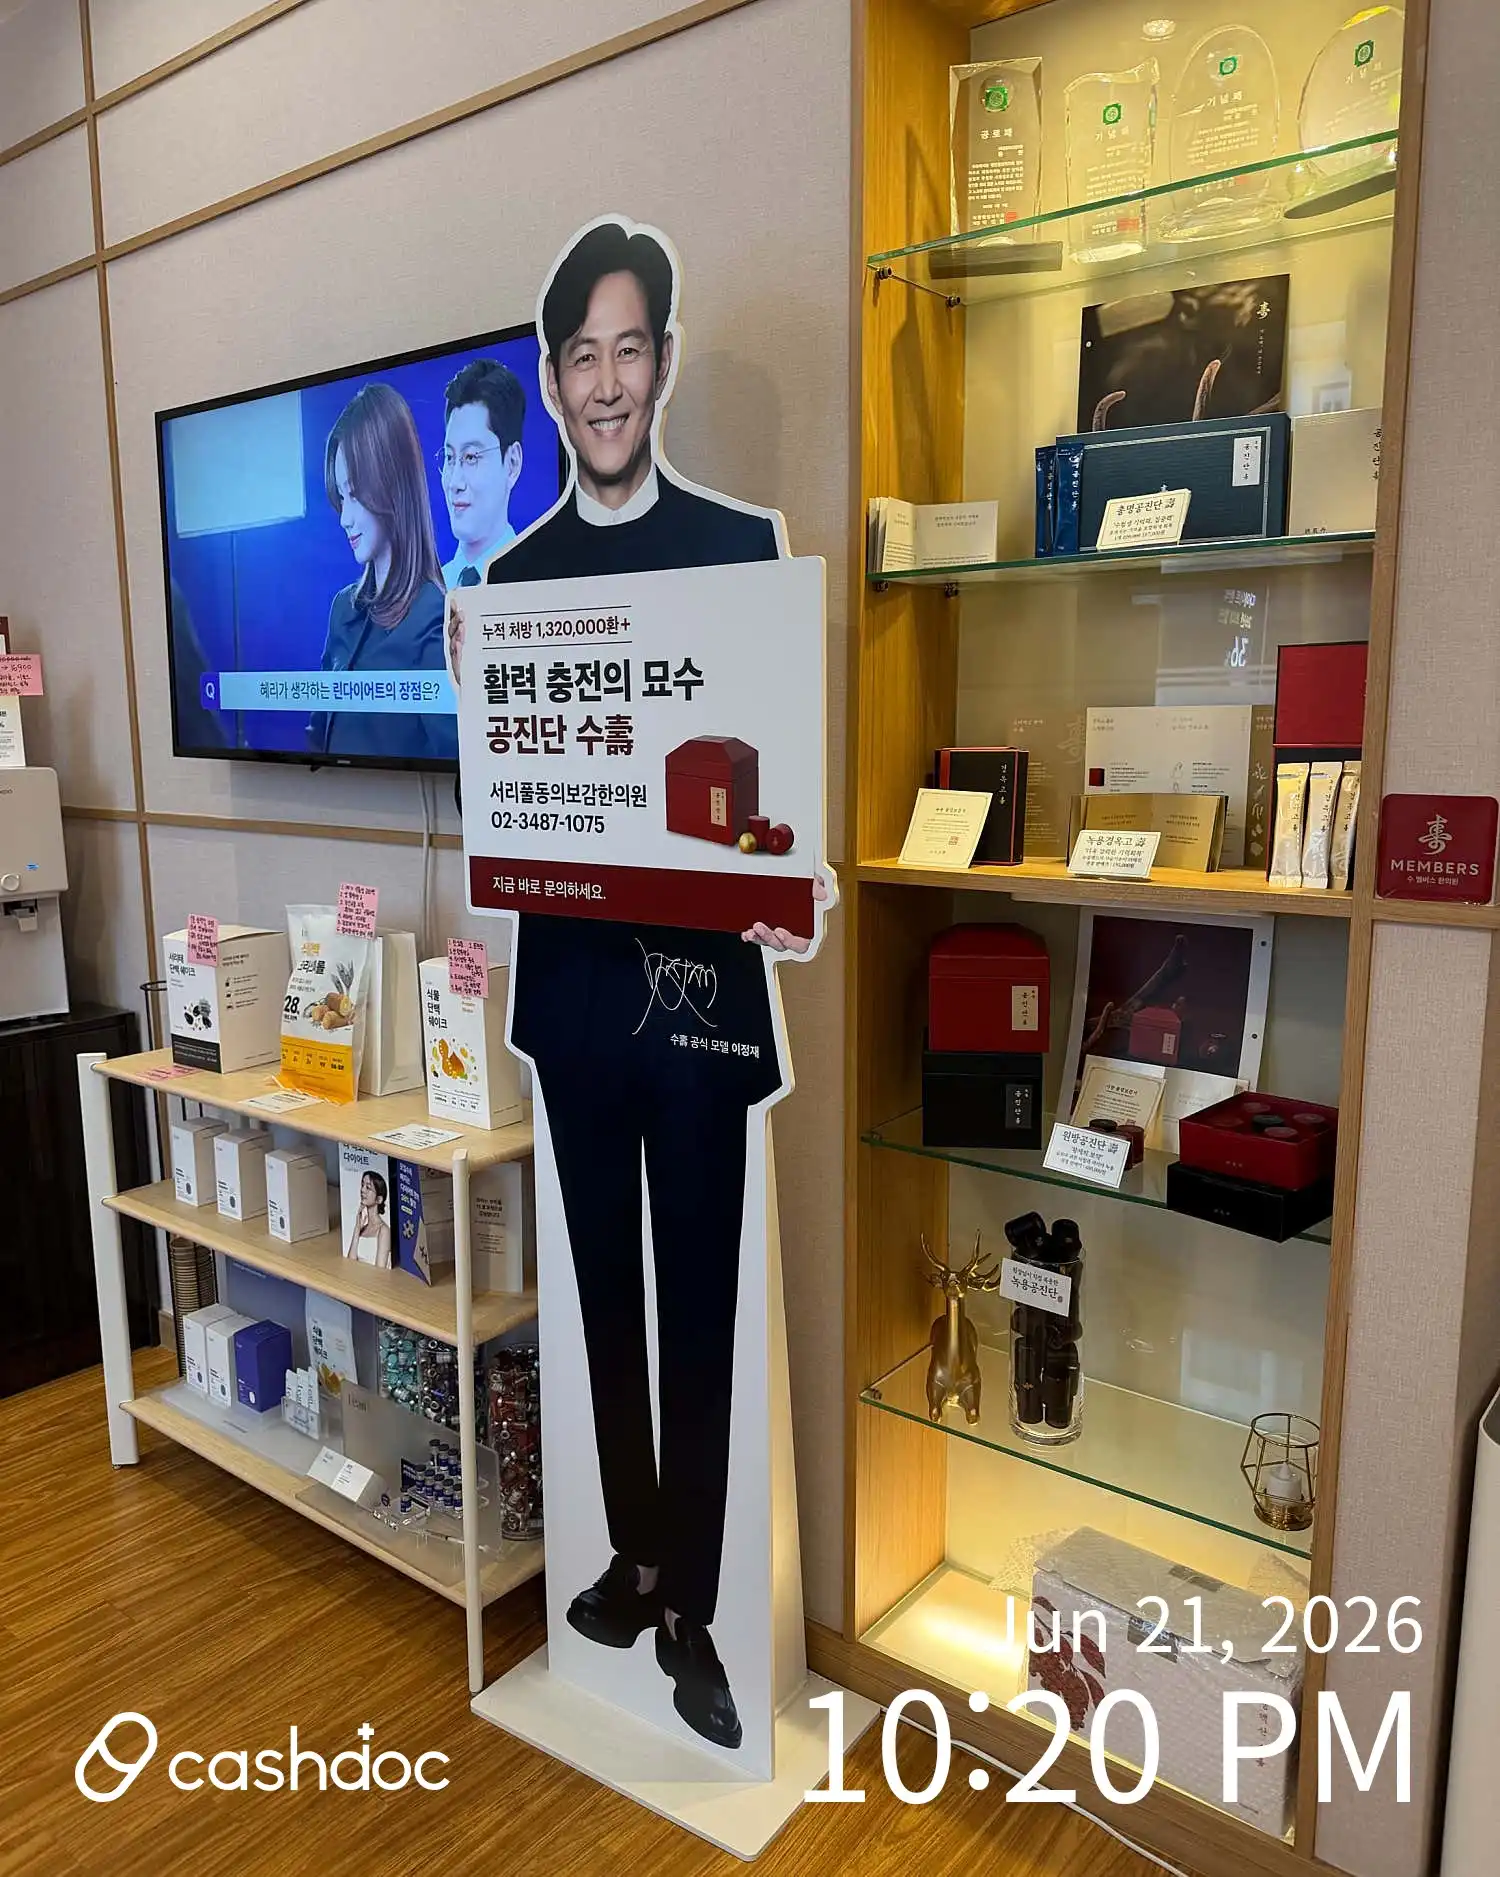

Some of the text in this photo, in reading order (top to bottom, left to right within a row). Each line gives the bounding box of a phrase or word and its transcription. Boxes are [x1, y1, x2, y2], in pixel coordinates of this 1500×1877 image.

[482, 616, 631, 641] 누적 처방 1,320,000환+
[205, 682, 216, 700] Q
[260, 681, 441, 701] 혜리가 생각하는 린다이어트의 장점은?
[483, 657, 704, 705] 활력 충전의 묘수
[486, 714, 634, 756] 공진단 수壽
[490, 780, 648, 808] 서리풀동의보감한의원
[491, 811, 605, 834] 02-3487-1075
[1086, 835, 1133, 847] 녹용경옥고
[1390, 859, 1480, 876] MEMBERS
[492, 875, 607, 900] 지금 바로 문의하세요.
[1438, 876, 1459, 886] 한의원
[690, 1035, 708, 1051] 공식
[711, 1039, 730, 1054] 모델
[731, 1042, 761, 1060] 이정재
[1062, 1130, 1107, 1151] 원방공진단
[343, 1152, 370, 1166] 다이어트
[1011, 1275, 1059, 1299] 녹용공진단
